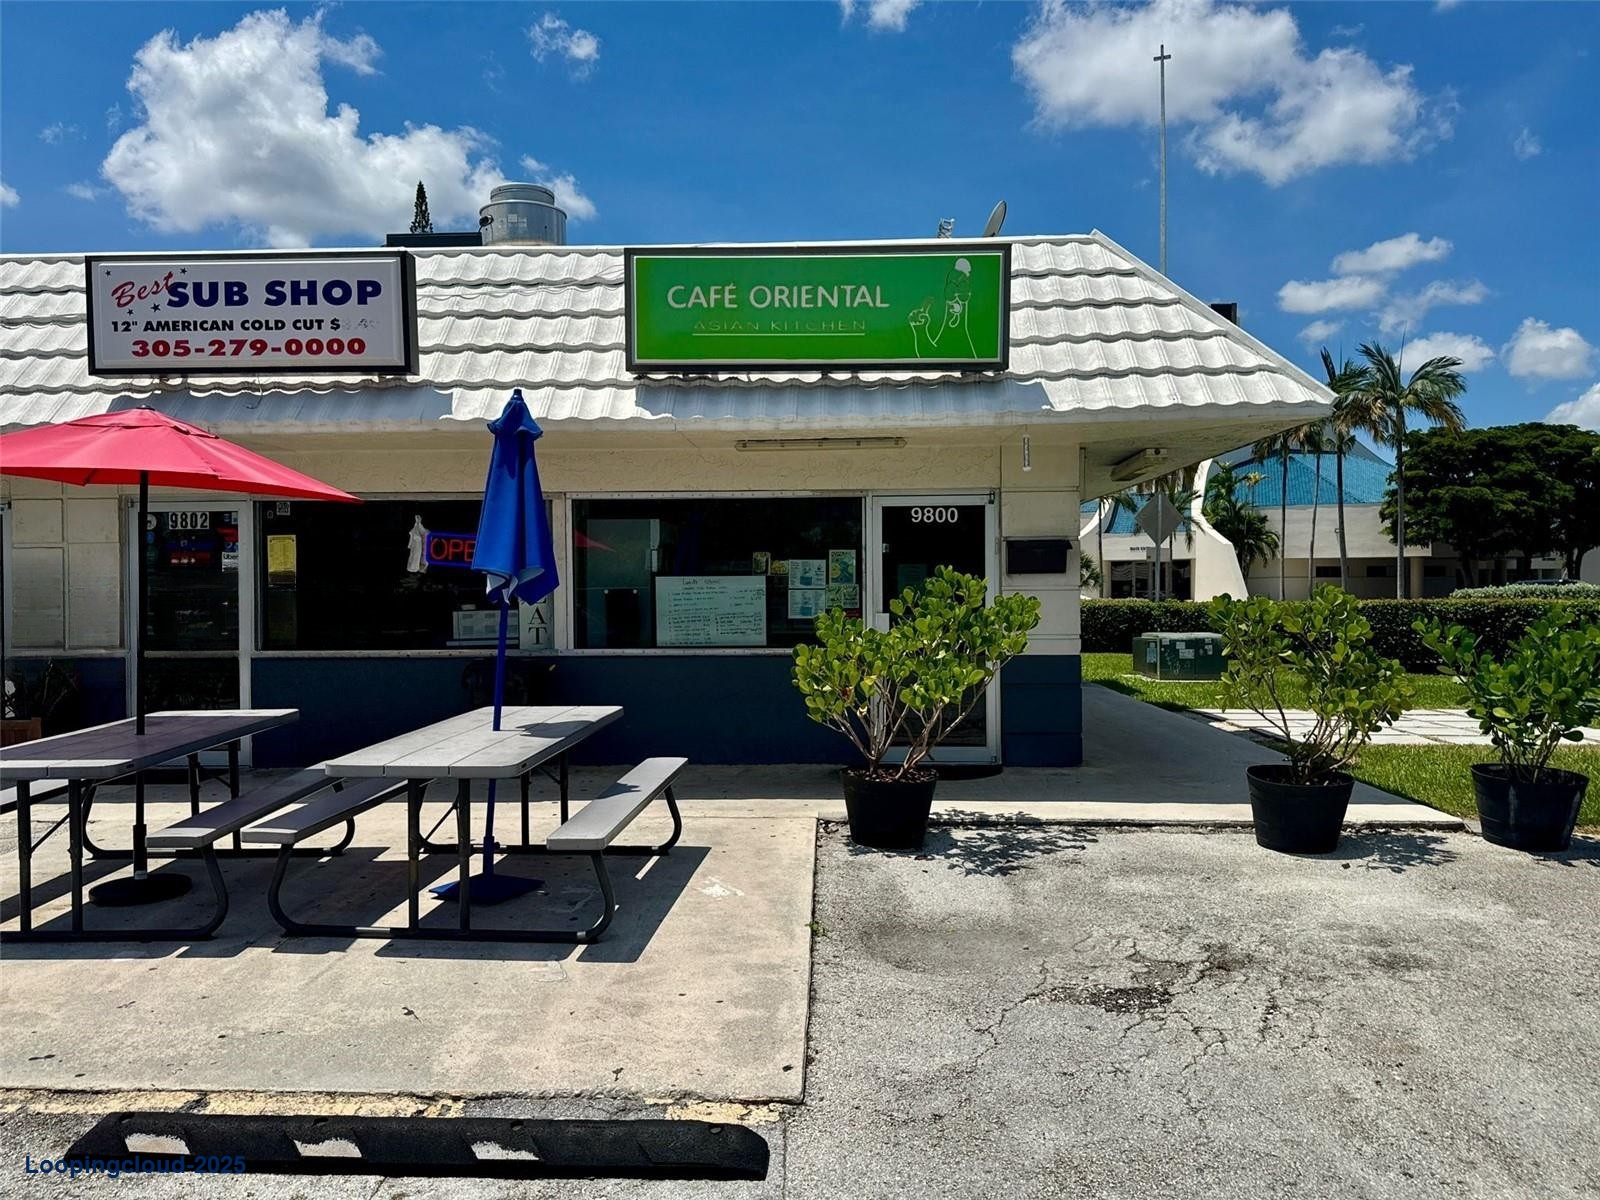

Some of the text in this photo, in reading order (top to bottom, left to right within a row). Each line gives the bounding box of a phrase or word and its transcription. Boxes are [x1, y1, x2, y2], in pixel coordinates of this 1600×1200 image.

[111, 271, 382, 309] Best SUB SHOP
[667, 282, 890, 309] CAFÉ ORIENTAL
[143, 320, 234, 332] AMERICAN
[240, 319, 286, 331] COLD
[292, 318, 324, 331] CUT
[694, 320, 866, 331] ASIAN KITCHEN
[131, 338, 366, 357] 305-279-0000
[170, 512, 209, 529] 9802
[911, 507, 959, 523] 9800
